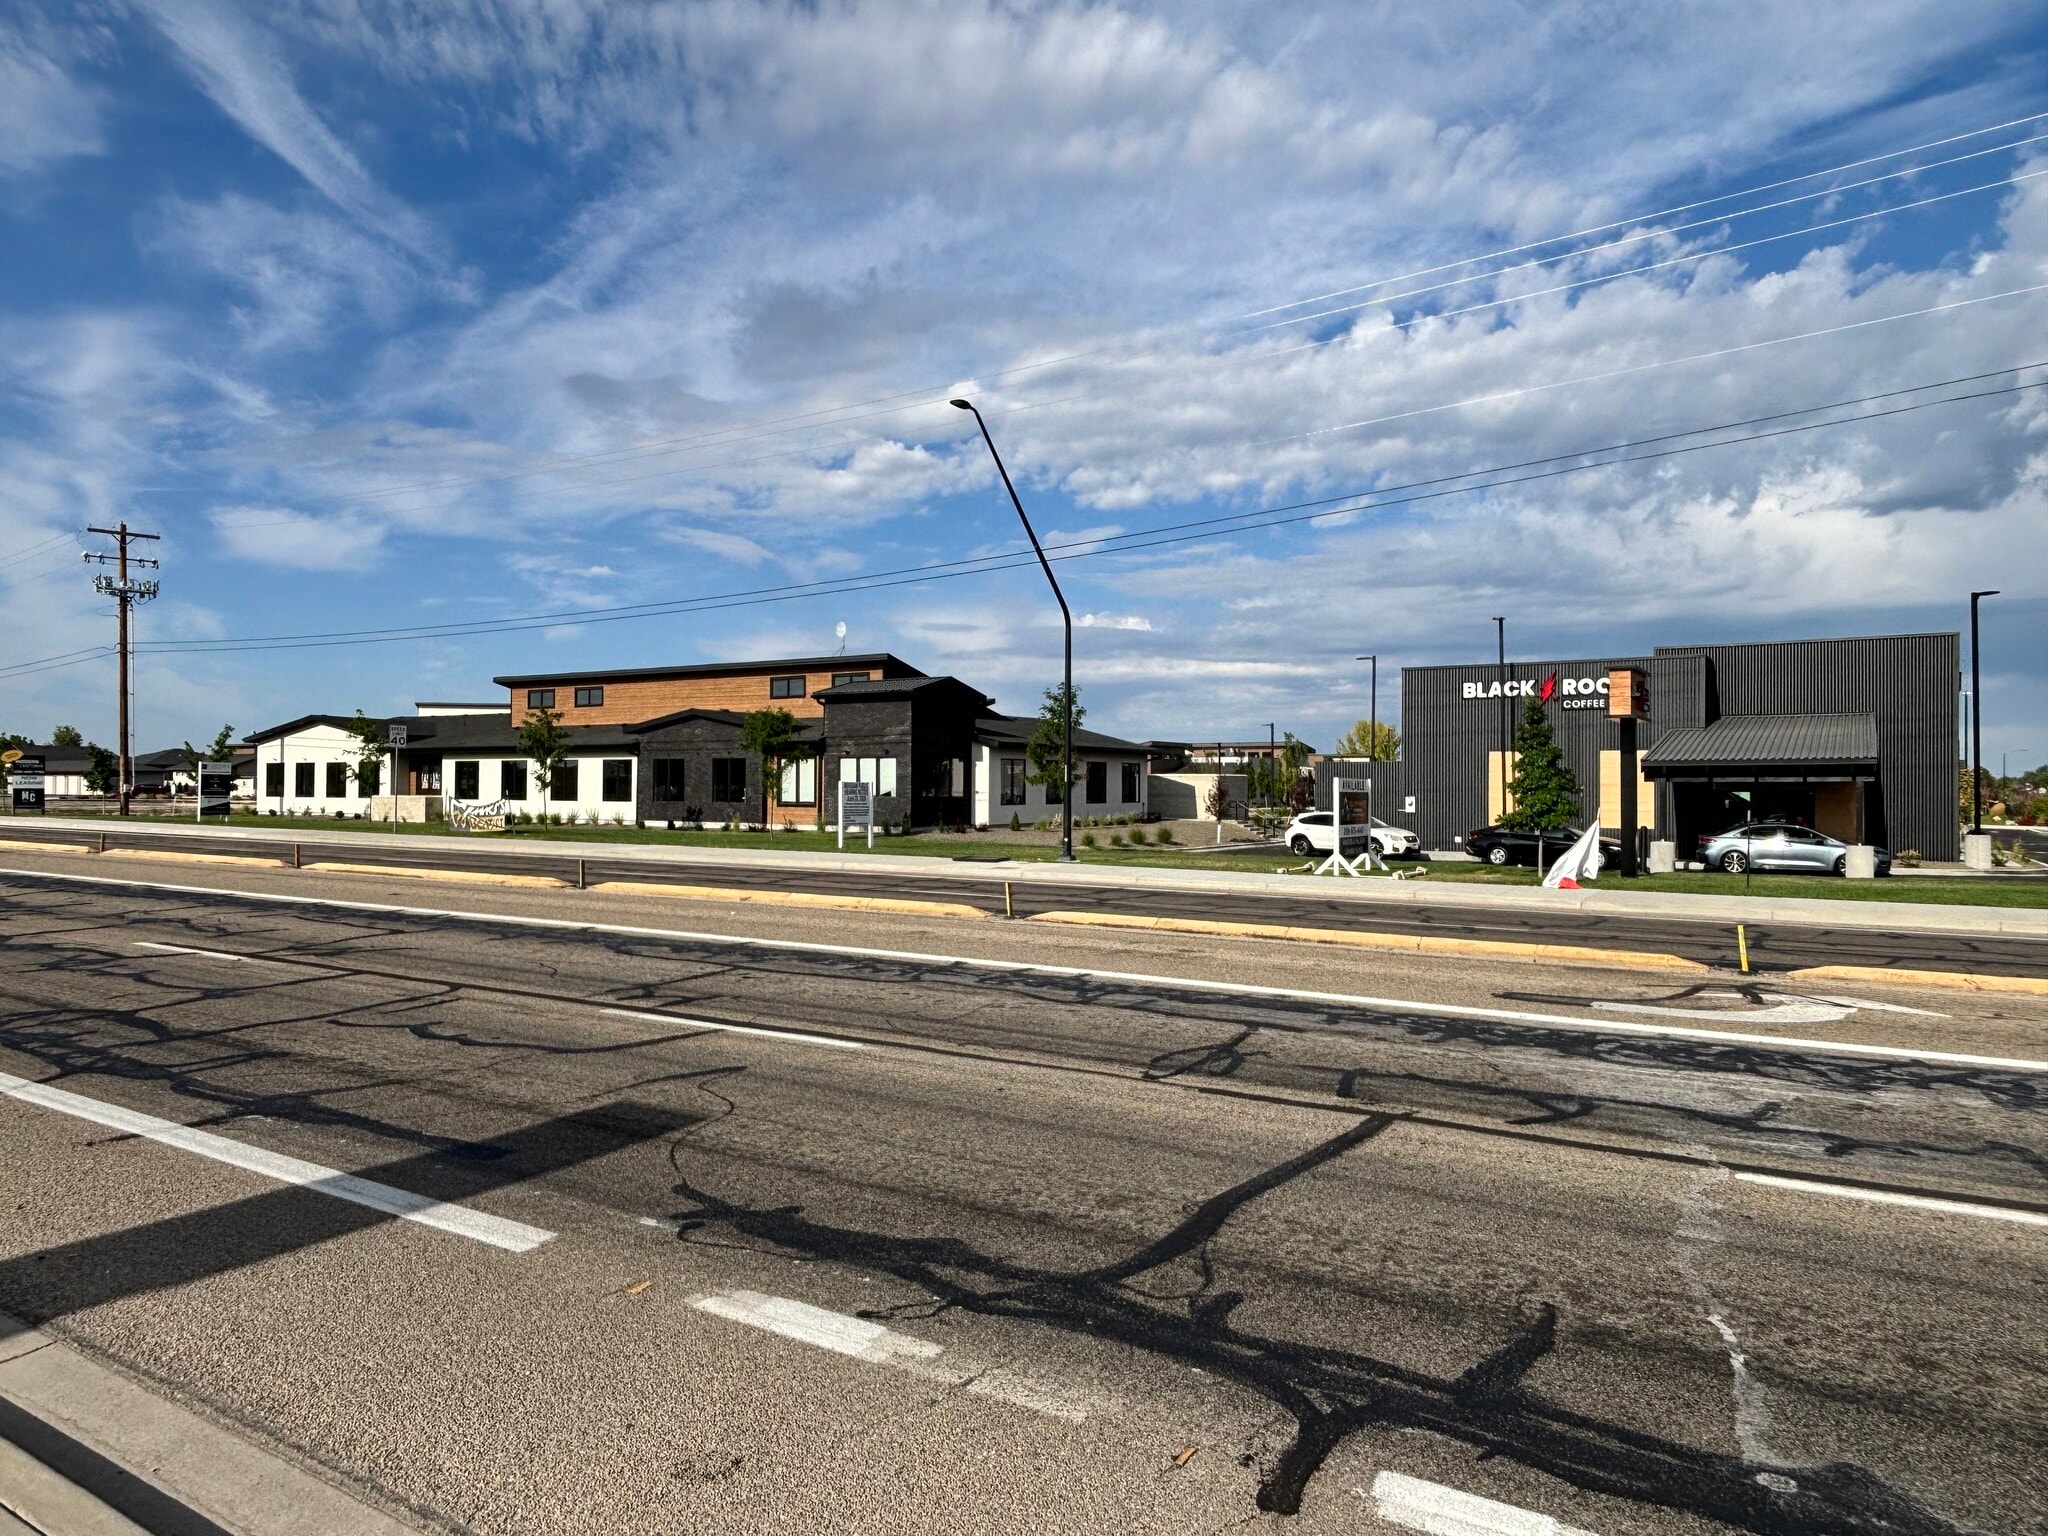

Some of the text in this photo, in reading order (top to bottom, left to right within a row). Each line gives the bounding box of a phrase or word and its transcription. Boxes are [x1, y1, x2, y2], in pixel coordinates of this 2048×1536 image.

[1462, 677, 1610, 699] BLACK ROC
[1563, 699, 1605, 709] COFFEE
[390, 736, 406, 746] 40
